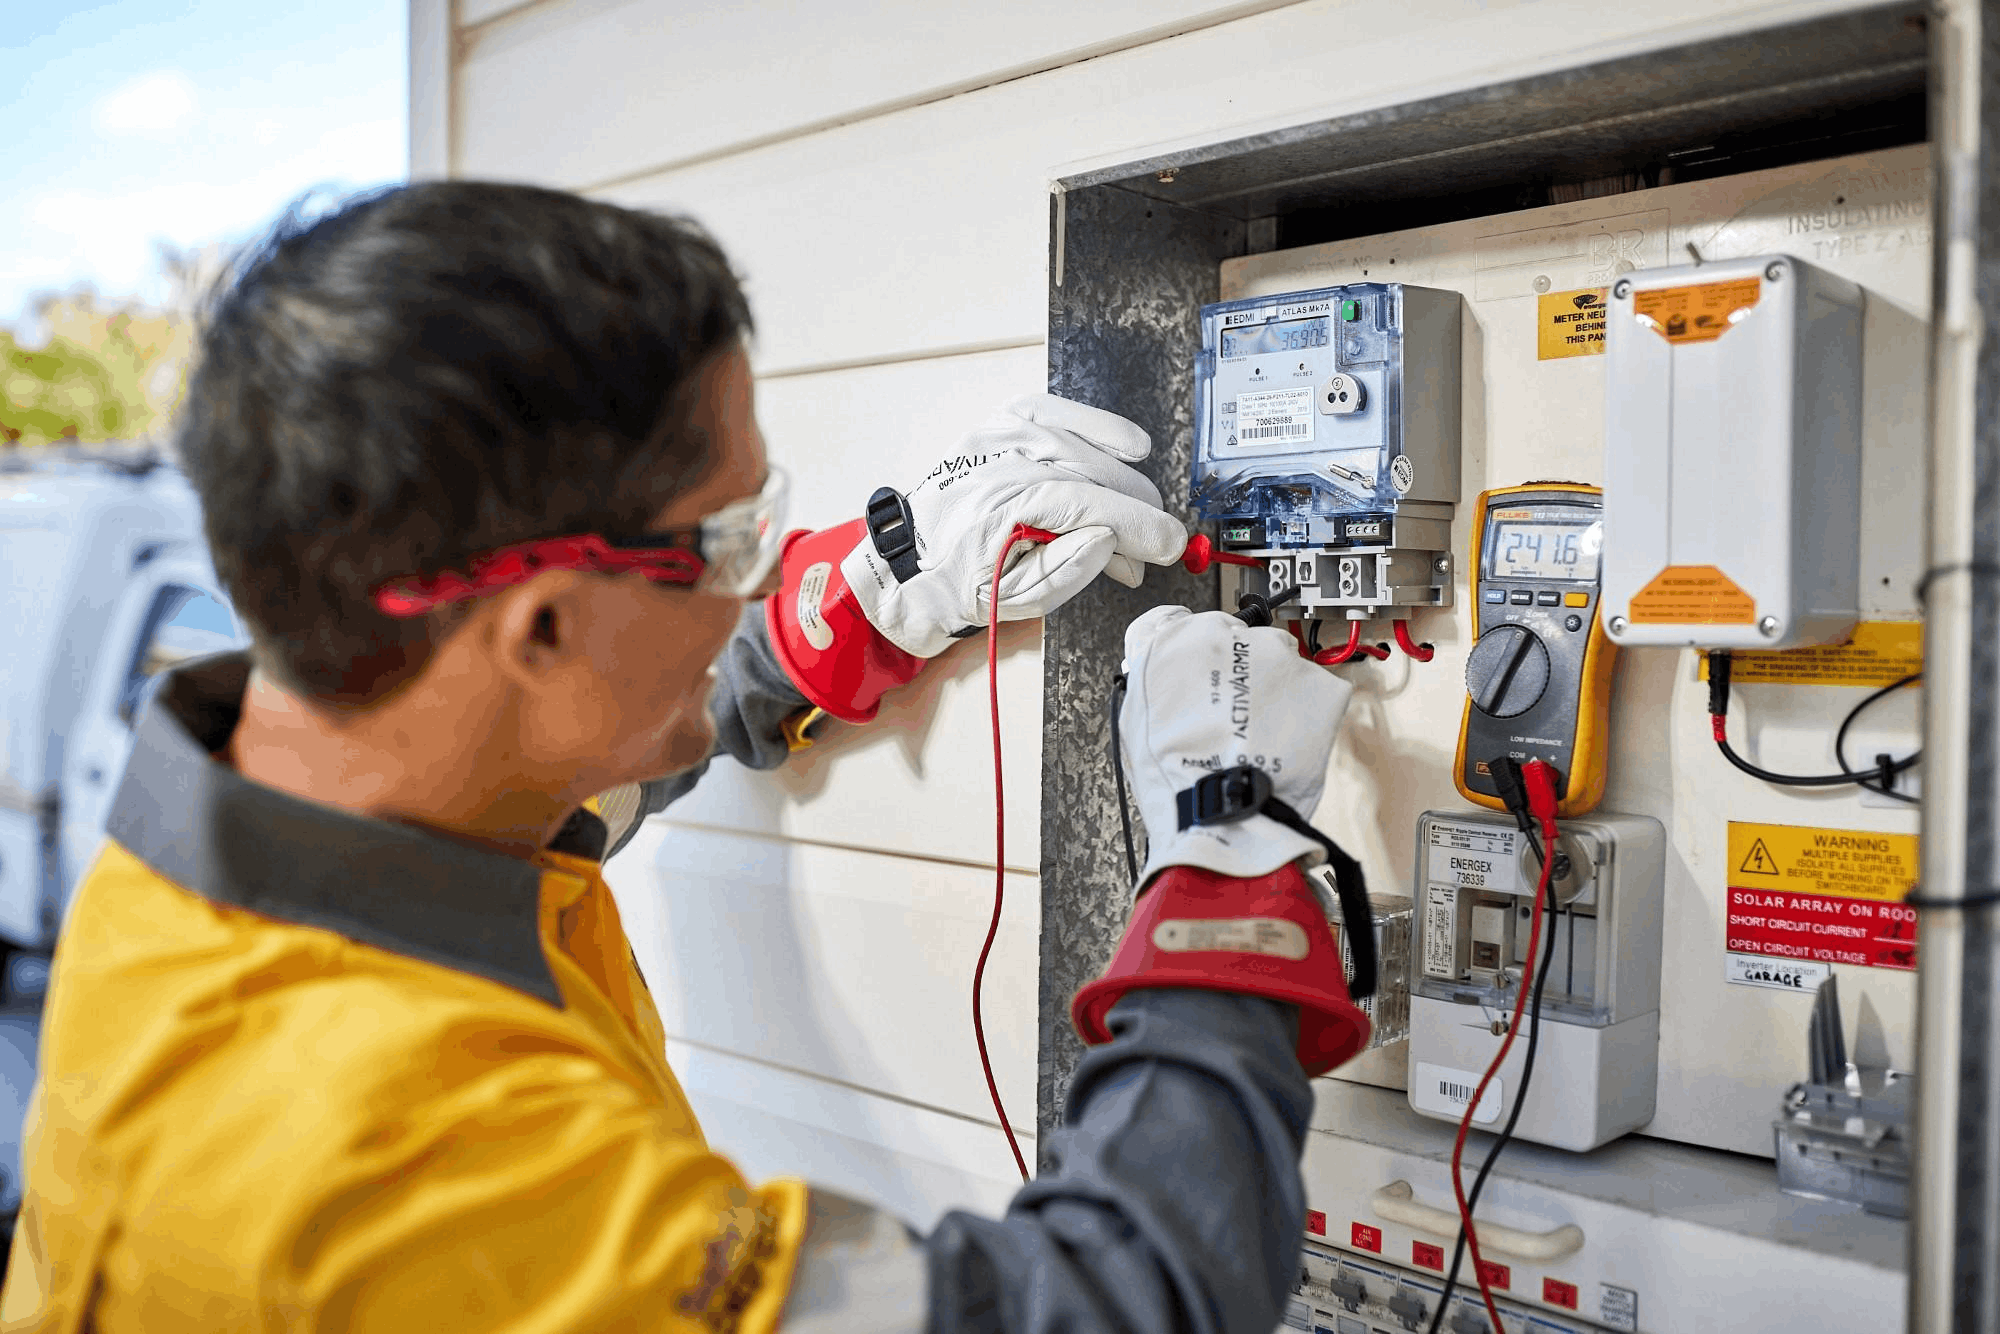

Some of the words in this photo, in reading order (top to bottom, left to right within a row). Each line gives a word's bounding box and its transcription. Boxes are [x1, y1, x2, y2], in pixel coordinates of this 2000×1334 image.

[1233, 313, 1255, 324] EDMI
[1281, 306, 1307, 317] ATLAS
[1308, 303, 1330, 313] Mk7A
[1554, 312, 1584, 324] METER
[1587, 310, 1606, 319] NEU
[1565, 334, 1585, 344] THIS
[1588, 332, 1606, 341] PAN
[1506, 533, 1577, 565] 241.6
[1229, 641, 1250, 740] ACTIVARMR
[1509, 751, 1526, 759] COM
[1814, 834, 1890, 852] WARNING
[1450, 857, 1492, 873] ENERGEX
[1802, 849, 1848, 861] MULTIPLE
[1852, 853, 1902, 865] SUPPLIES
[1796, 859, 1835, 870] ISOLATE
[1839, 862, 1856, 872] ALL
[1859, 864, 1906, 876] SUPPLIES
[1456, 871, 1485, 886] 736339
[1787, 868, 1824, 880] BEFORE
[1828, 871, 1873, 884] WORKING
[1876, 875, 1891, 885] ON
[1815, 880, 1887, 895] SWITCHBOARD
[1733, 892, 1785, 908] SOLAR
[1789, 898, 1843, 914] ARRAY
[1848, 903, 1873, 917] ON
[1879, 907, 1916, 922] ROO
[1730, 914, 1767, 927] SHORT
[1767, 918, 1811, 933] CIRCUIT
[1812, 923, 1868, 938] CURRENT
[1729, 938, 1761, 951] OPEN
[1763, 942, 1810, 957] CIRCUIT
[1813, 948, 1866, 963] VOLTAGE
[1737, 958, 1773, 972] Inverter
[1775, 962, 1817, 976] Location
[1745, 970, 1803, 988] GARAGE
